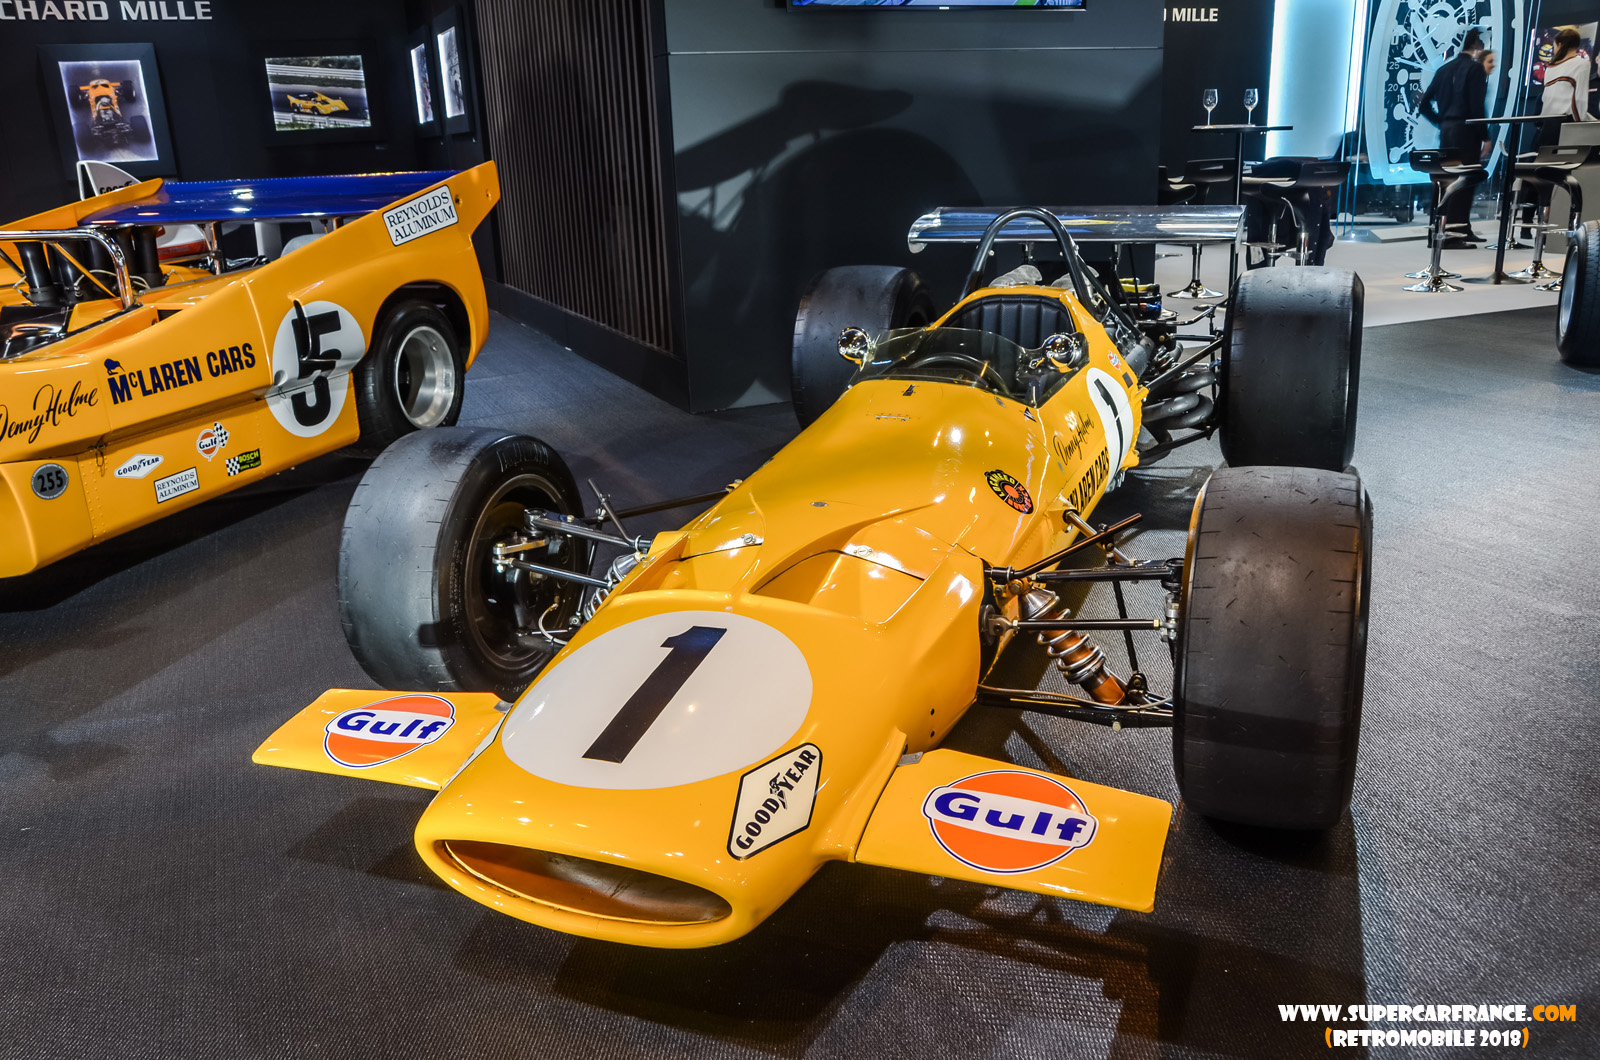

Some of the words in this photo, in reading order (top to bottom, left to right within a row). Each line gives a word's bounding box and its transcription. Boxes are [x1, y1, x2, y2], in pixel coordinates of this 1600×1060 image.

[120, 1, 213, 20] MILLE
[1172, 8, 1219, 22] MILLE
[1389, 62, 1400, 70] 25
[1387, 83, 1399, 92] 20
[1409, 83, 1419, 91] 10
[386, 191, 450, 228] REYNOLDS
[394, 205, 455, 242] ALUMINUM
[206, 343, 256, 378] CARS
[291, 310, 342, 427] 5
[33, 380, 99, 427] Hulme
[1094, 378, 1124, 476] 1
[199, 437, 217, 450] Gulf
[238, 450, 259, 463] BOSCH
[1053, 433, 1084, 466] Denny
[37, 470, 64, 493] 255
[156, 471, 195, 491] REYNOLDS
[1095, 446, 1110, 491] CARS
[158, 480, 198, 499] ALUMINUM
[581, 625, 728, 764] 1
[337, 711, 447, 739] Gulf
[934, 792, 1088, 842] Gulf
